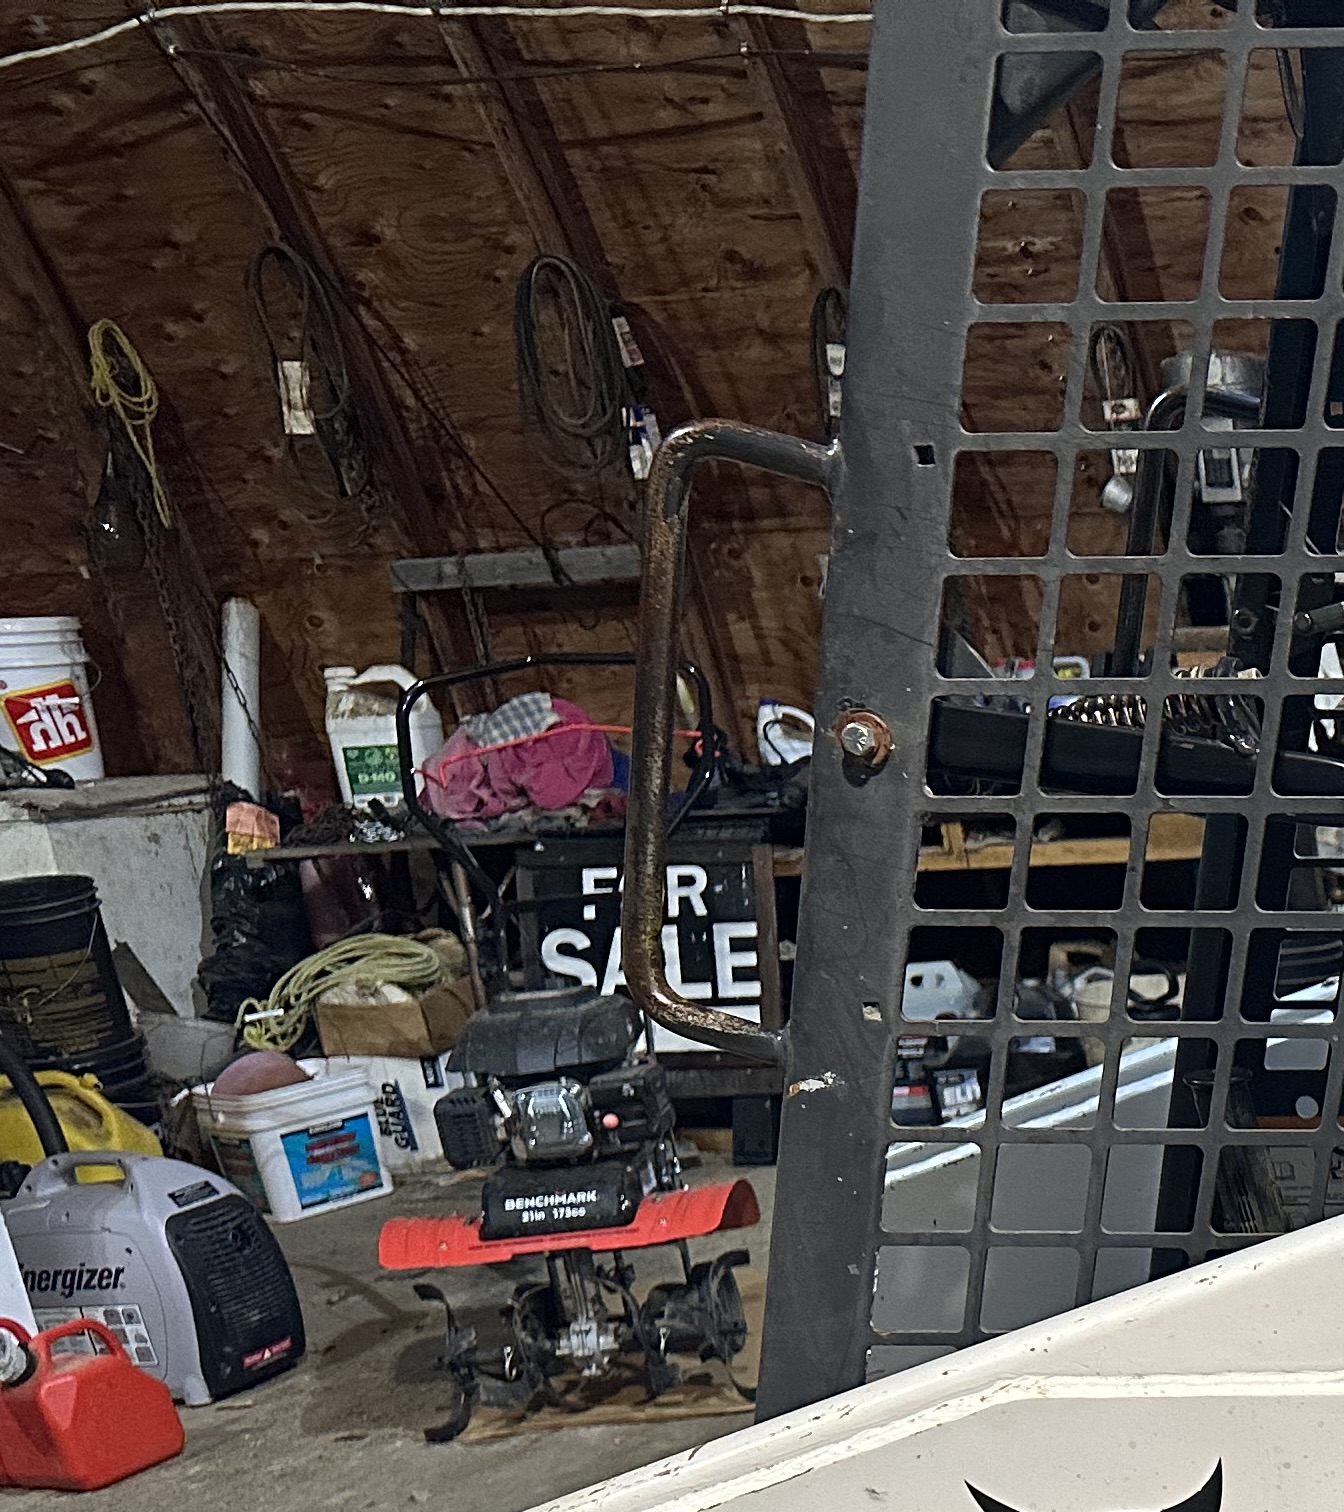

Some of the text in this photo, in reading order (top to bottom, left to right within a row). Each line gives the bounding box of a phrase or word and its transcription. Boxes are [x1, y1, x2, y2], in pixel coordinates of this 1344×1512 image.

[582, 865, 708, 920] FR
[505, 1190, 597, 1211] BENCHMARK
[19, 1262, 124, 1298] nergizer
